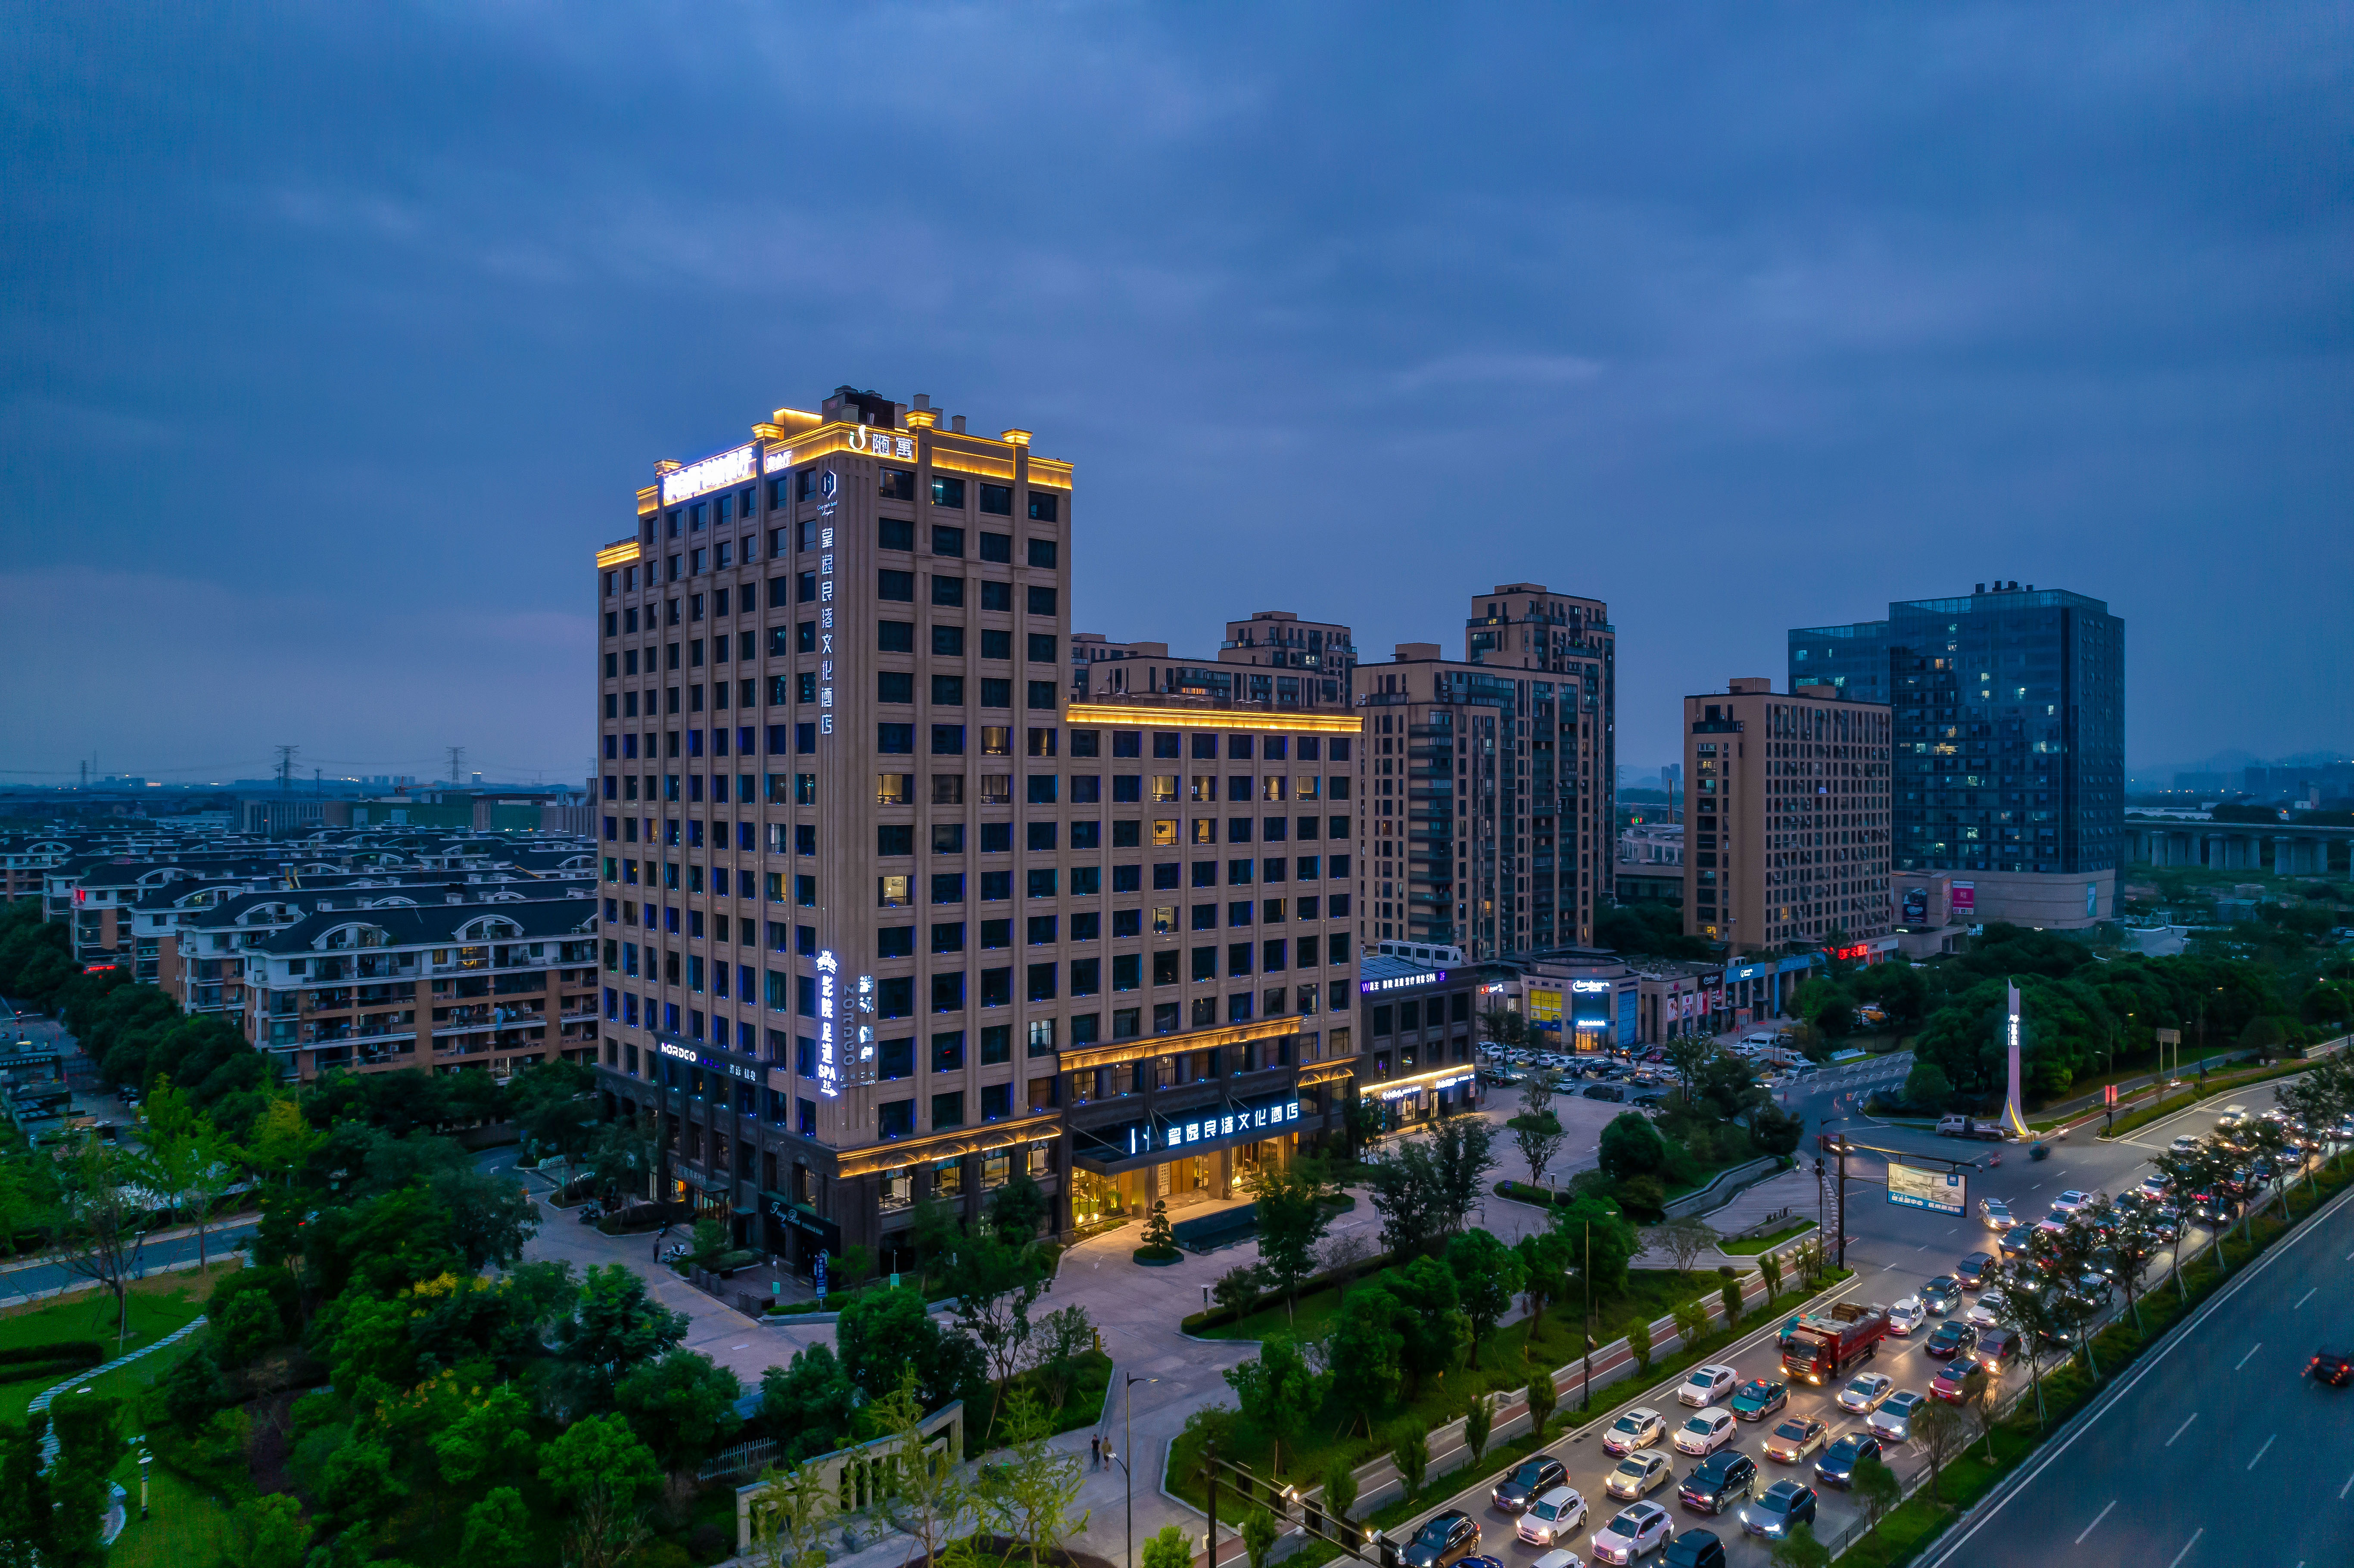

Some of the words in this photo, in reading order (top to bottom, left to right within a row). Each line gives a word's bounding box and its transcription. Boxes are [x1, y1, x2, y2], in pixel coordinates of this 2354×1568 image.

[1426, 973, 1436, 983] SPA
[843, 985, 855, 1066] NORDGO
[661, 1042, 696, 1062] NORDGO
[818, 1064, 836, 1081] SPA
[822, 1079, 832, 1089] 2F
